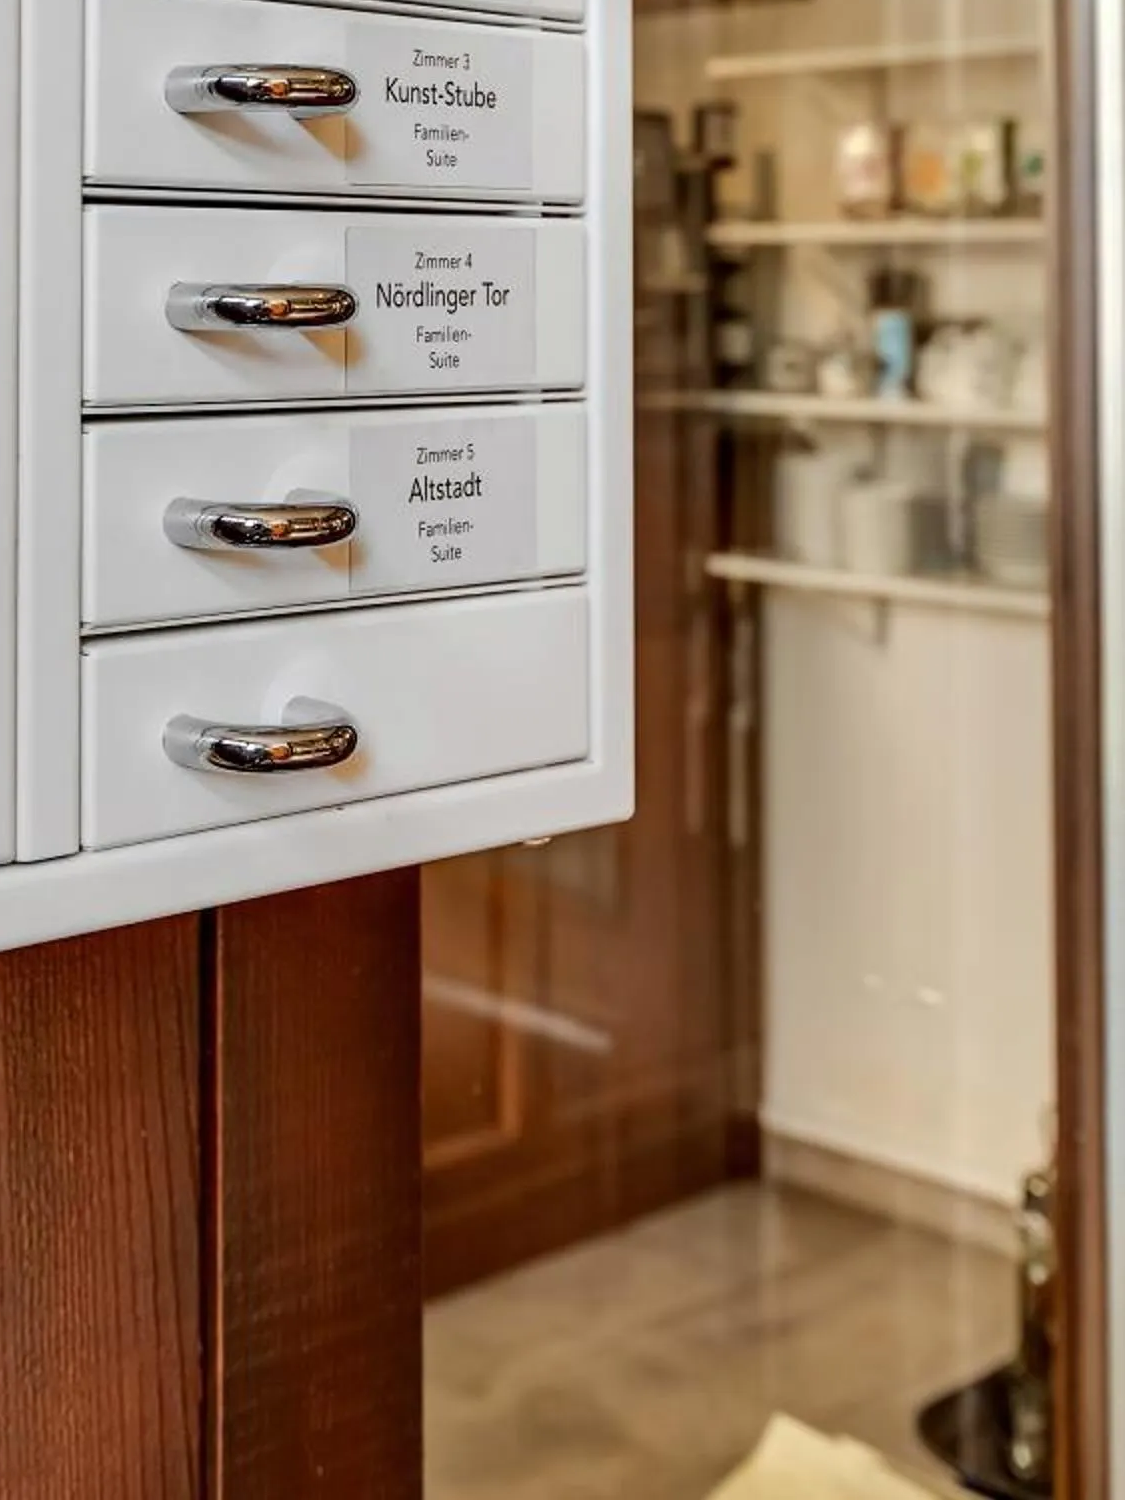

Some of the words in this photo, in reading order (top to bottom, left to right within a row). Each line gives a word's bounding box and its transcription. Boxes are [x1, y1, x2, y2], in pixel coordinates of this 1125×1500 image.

[412, 49, 460, 70] Zimmer
[463, 53, 471, 70] 3
[385, 76, 497, 109] Kunst-Stube
[414, 123, 470, 142] Familien-
[426, 150, 458, 168] Suite
[415, 252, 462, 270] Zimmer
[464, 252, 472, 269] 4
[376, 281, 477, 315] Nördlinger
[481, 281, 510, 306] Tor
[416, 326, 472, 343] Familien-
[428, 352, 460, 369] Suite
[416, 446, 464, 465] Zimmer
[466, 443, 476, 461] 5
[408, 472, 483, 503] Altstadt
[417, 518, 474, 539] Familien-
[430, 545, 463, 563] Suite
